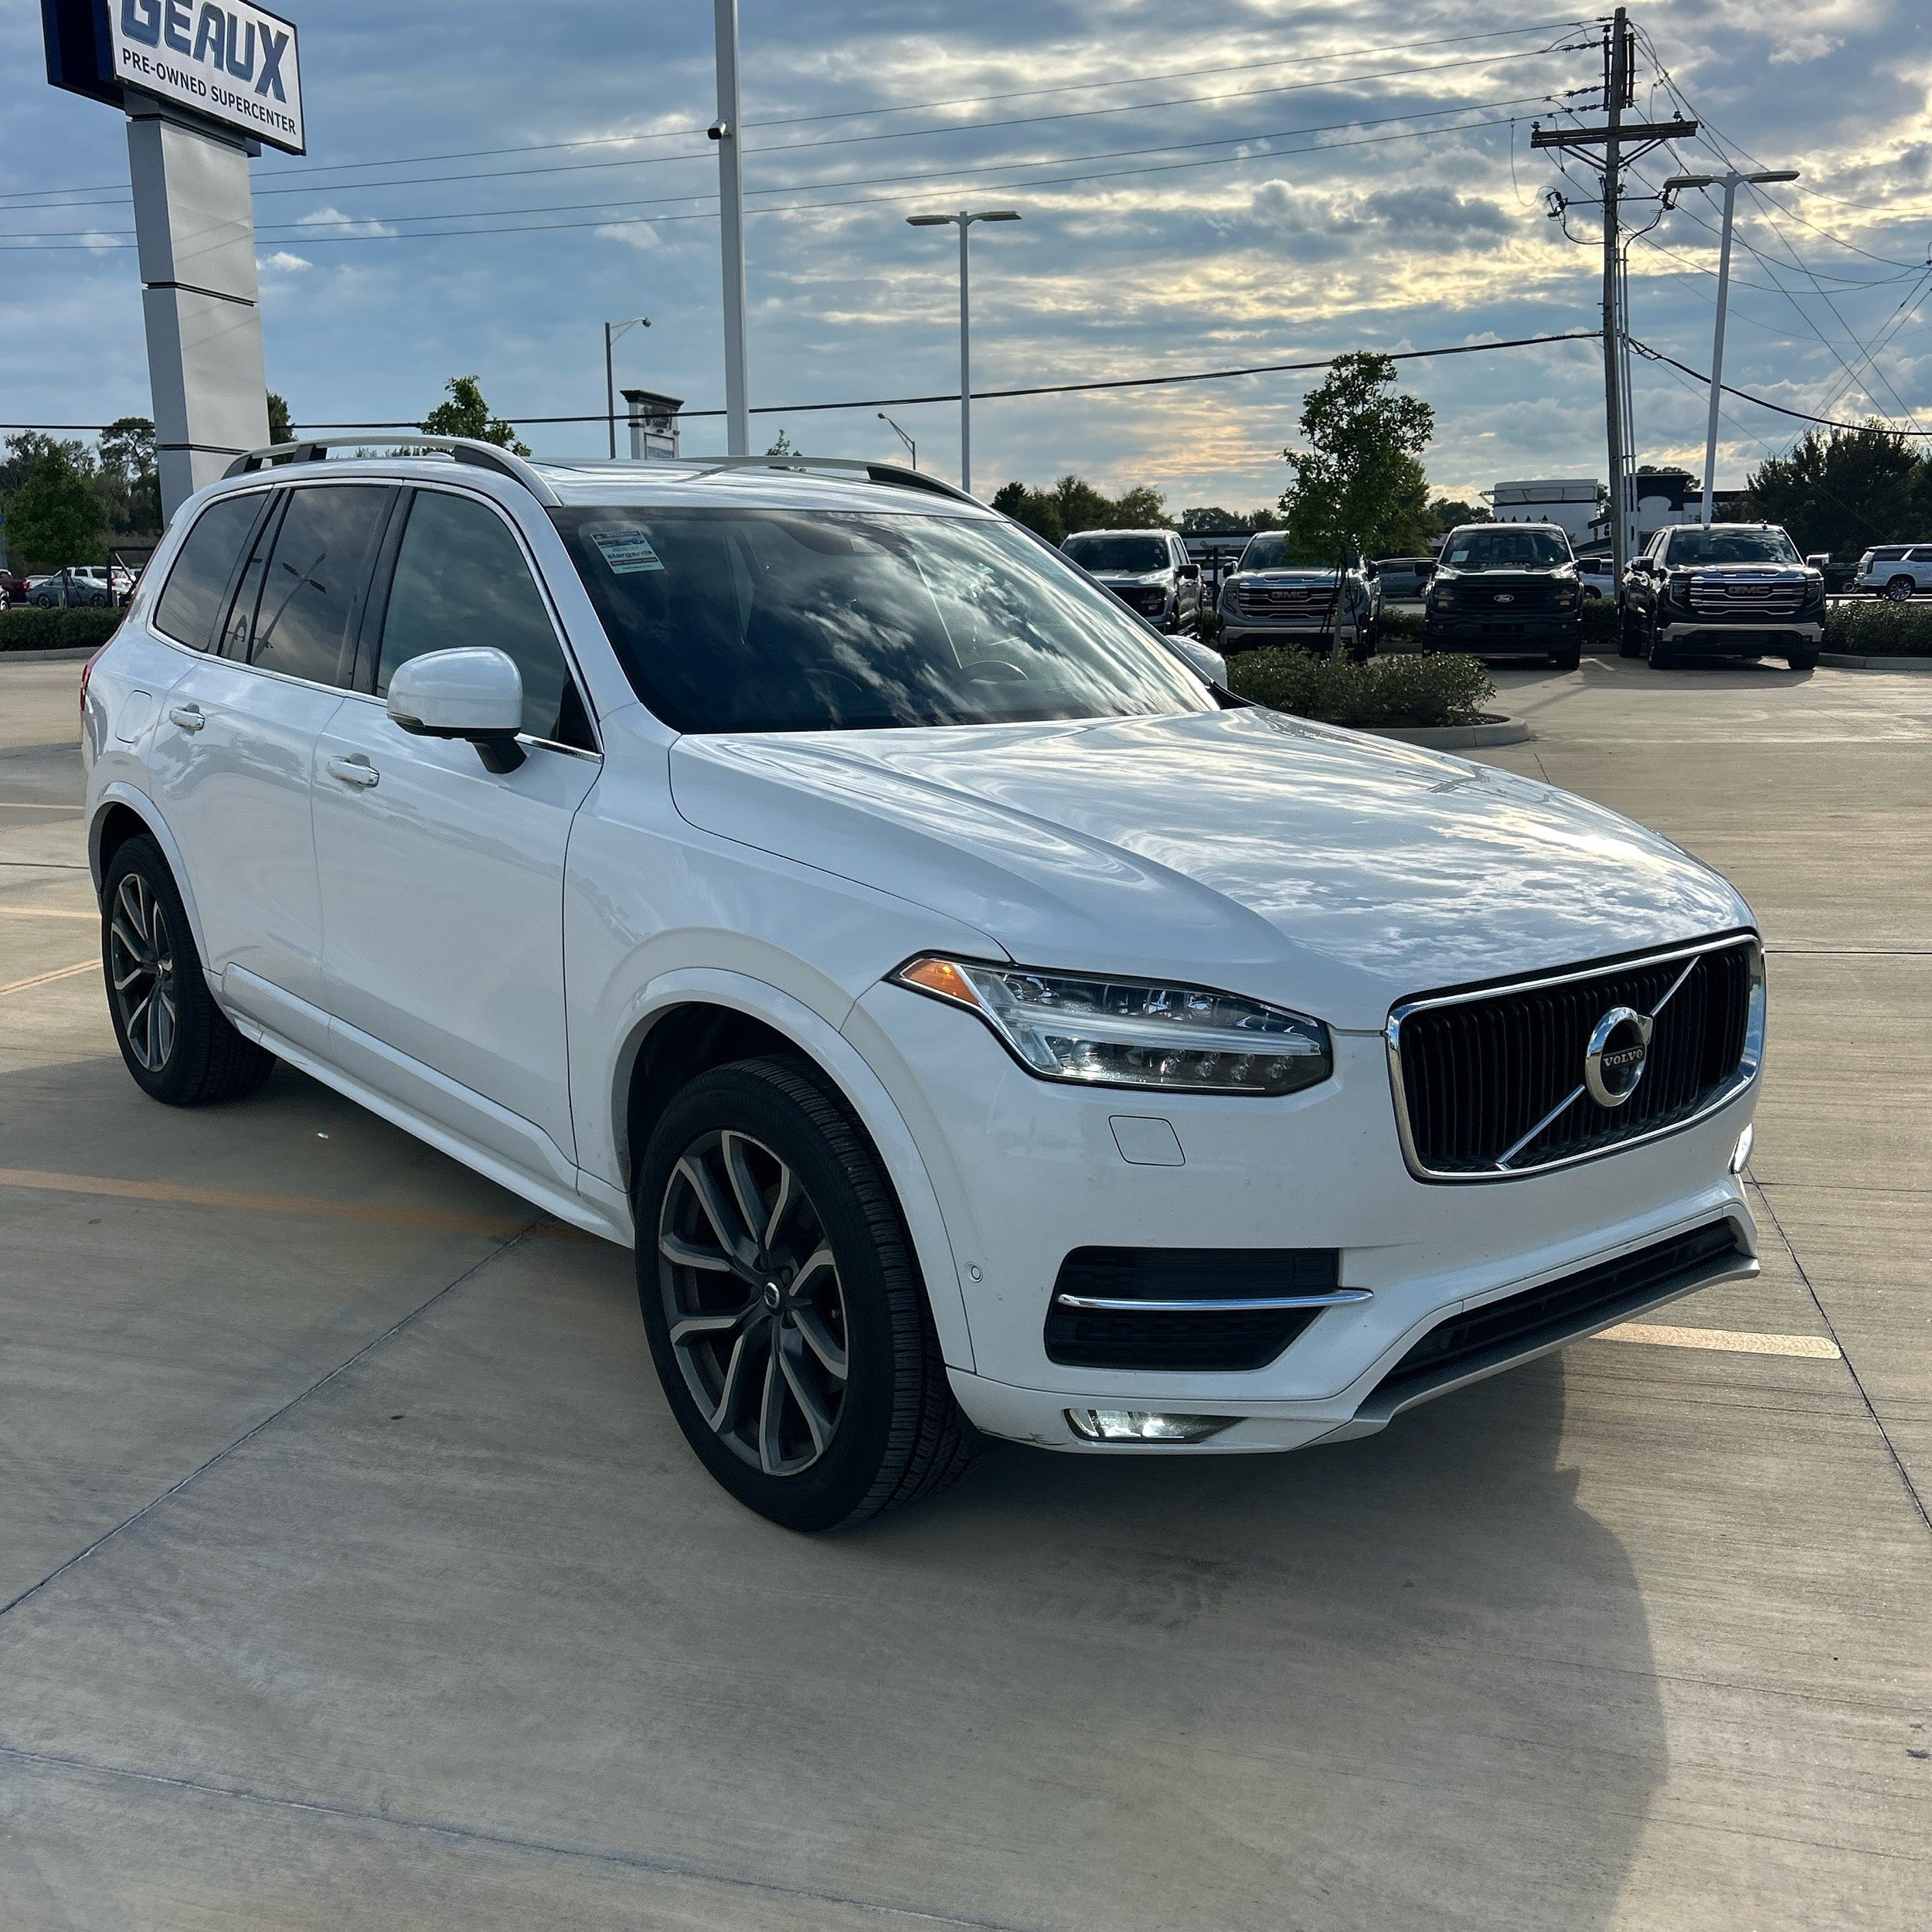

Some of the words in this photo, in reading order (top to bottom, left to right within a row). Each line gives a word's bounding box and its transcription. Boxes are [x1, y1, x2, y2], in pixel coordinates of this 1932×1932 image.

[121, 0, 290, 103] GEAUX
[123, 47, 206, 97] PRE-OWNED
[211, 86, 296, 134] SUPERCENTER
[1604, 1049, 1643, 1066] VOLVO
